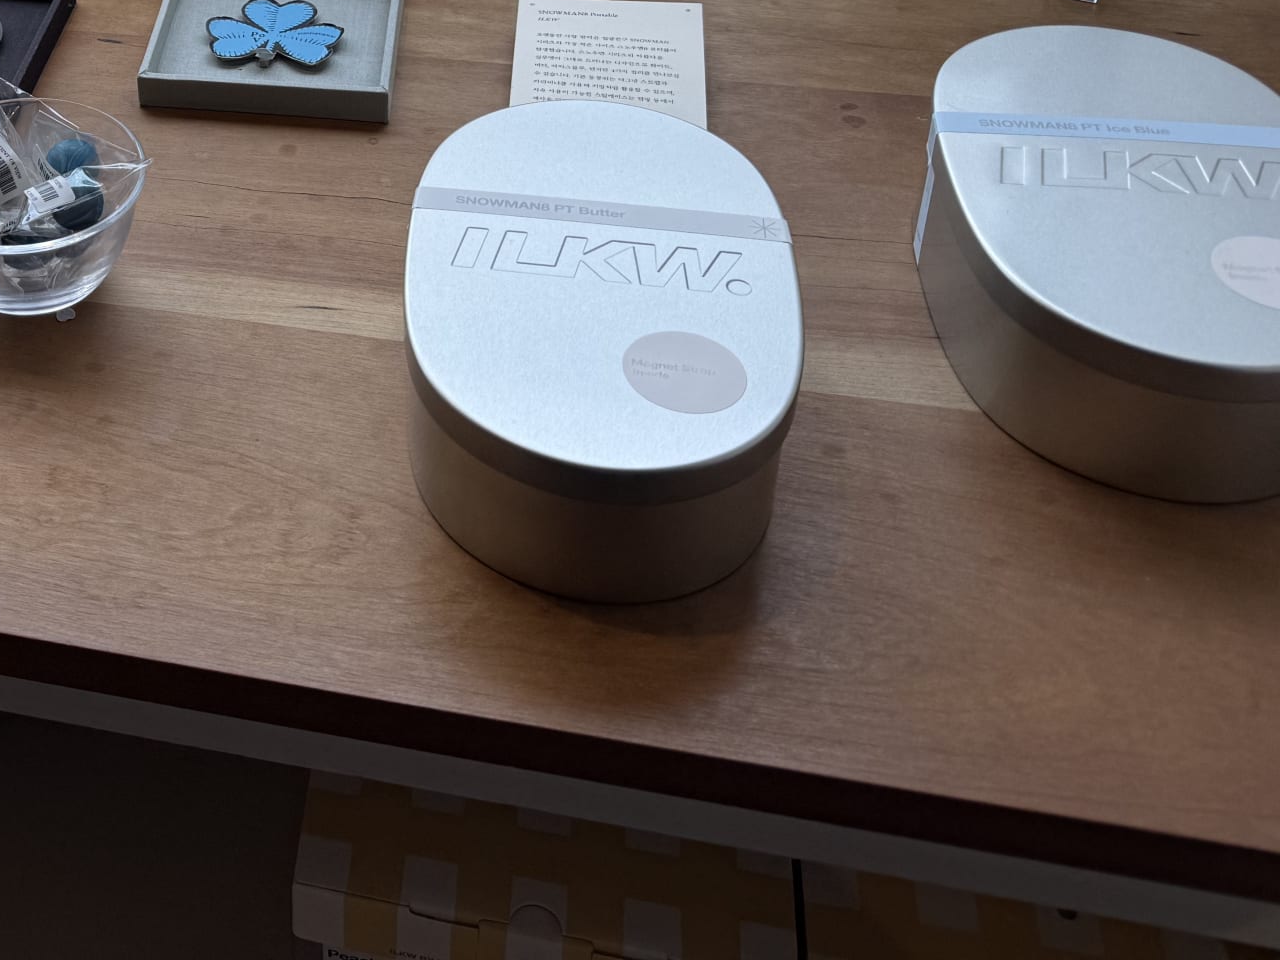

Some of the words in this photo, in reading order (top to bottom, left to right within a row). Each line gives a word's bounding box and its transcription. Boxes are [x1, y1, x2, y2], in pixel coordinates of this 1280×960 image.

[1080, 124, 1100, 132] PT
[1106, 125, 1130, 133] Ice
[1134, 126, 1170, 136] Blue
[554, 204, 575, 214] PT
[578, 206, 626, 218] Butter
[450, 226, 753, 297] ILKW.
